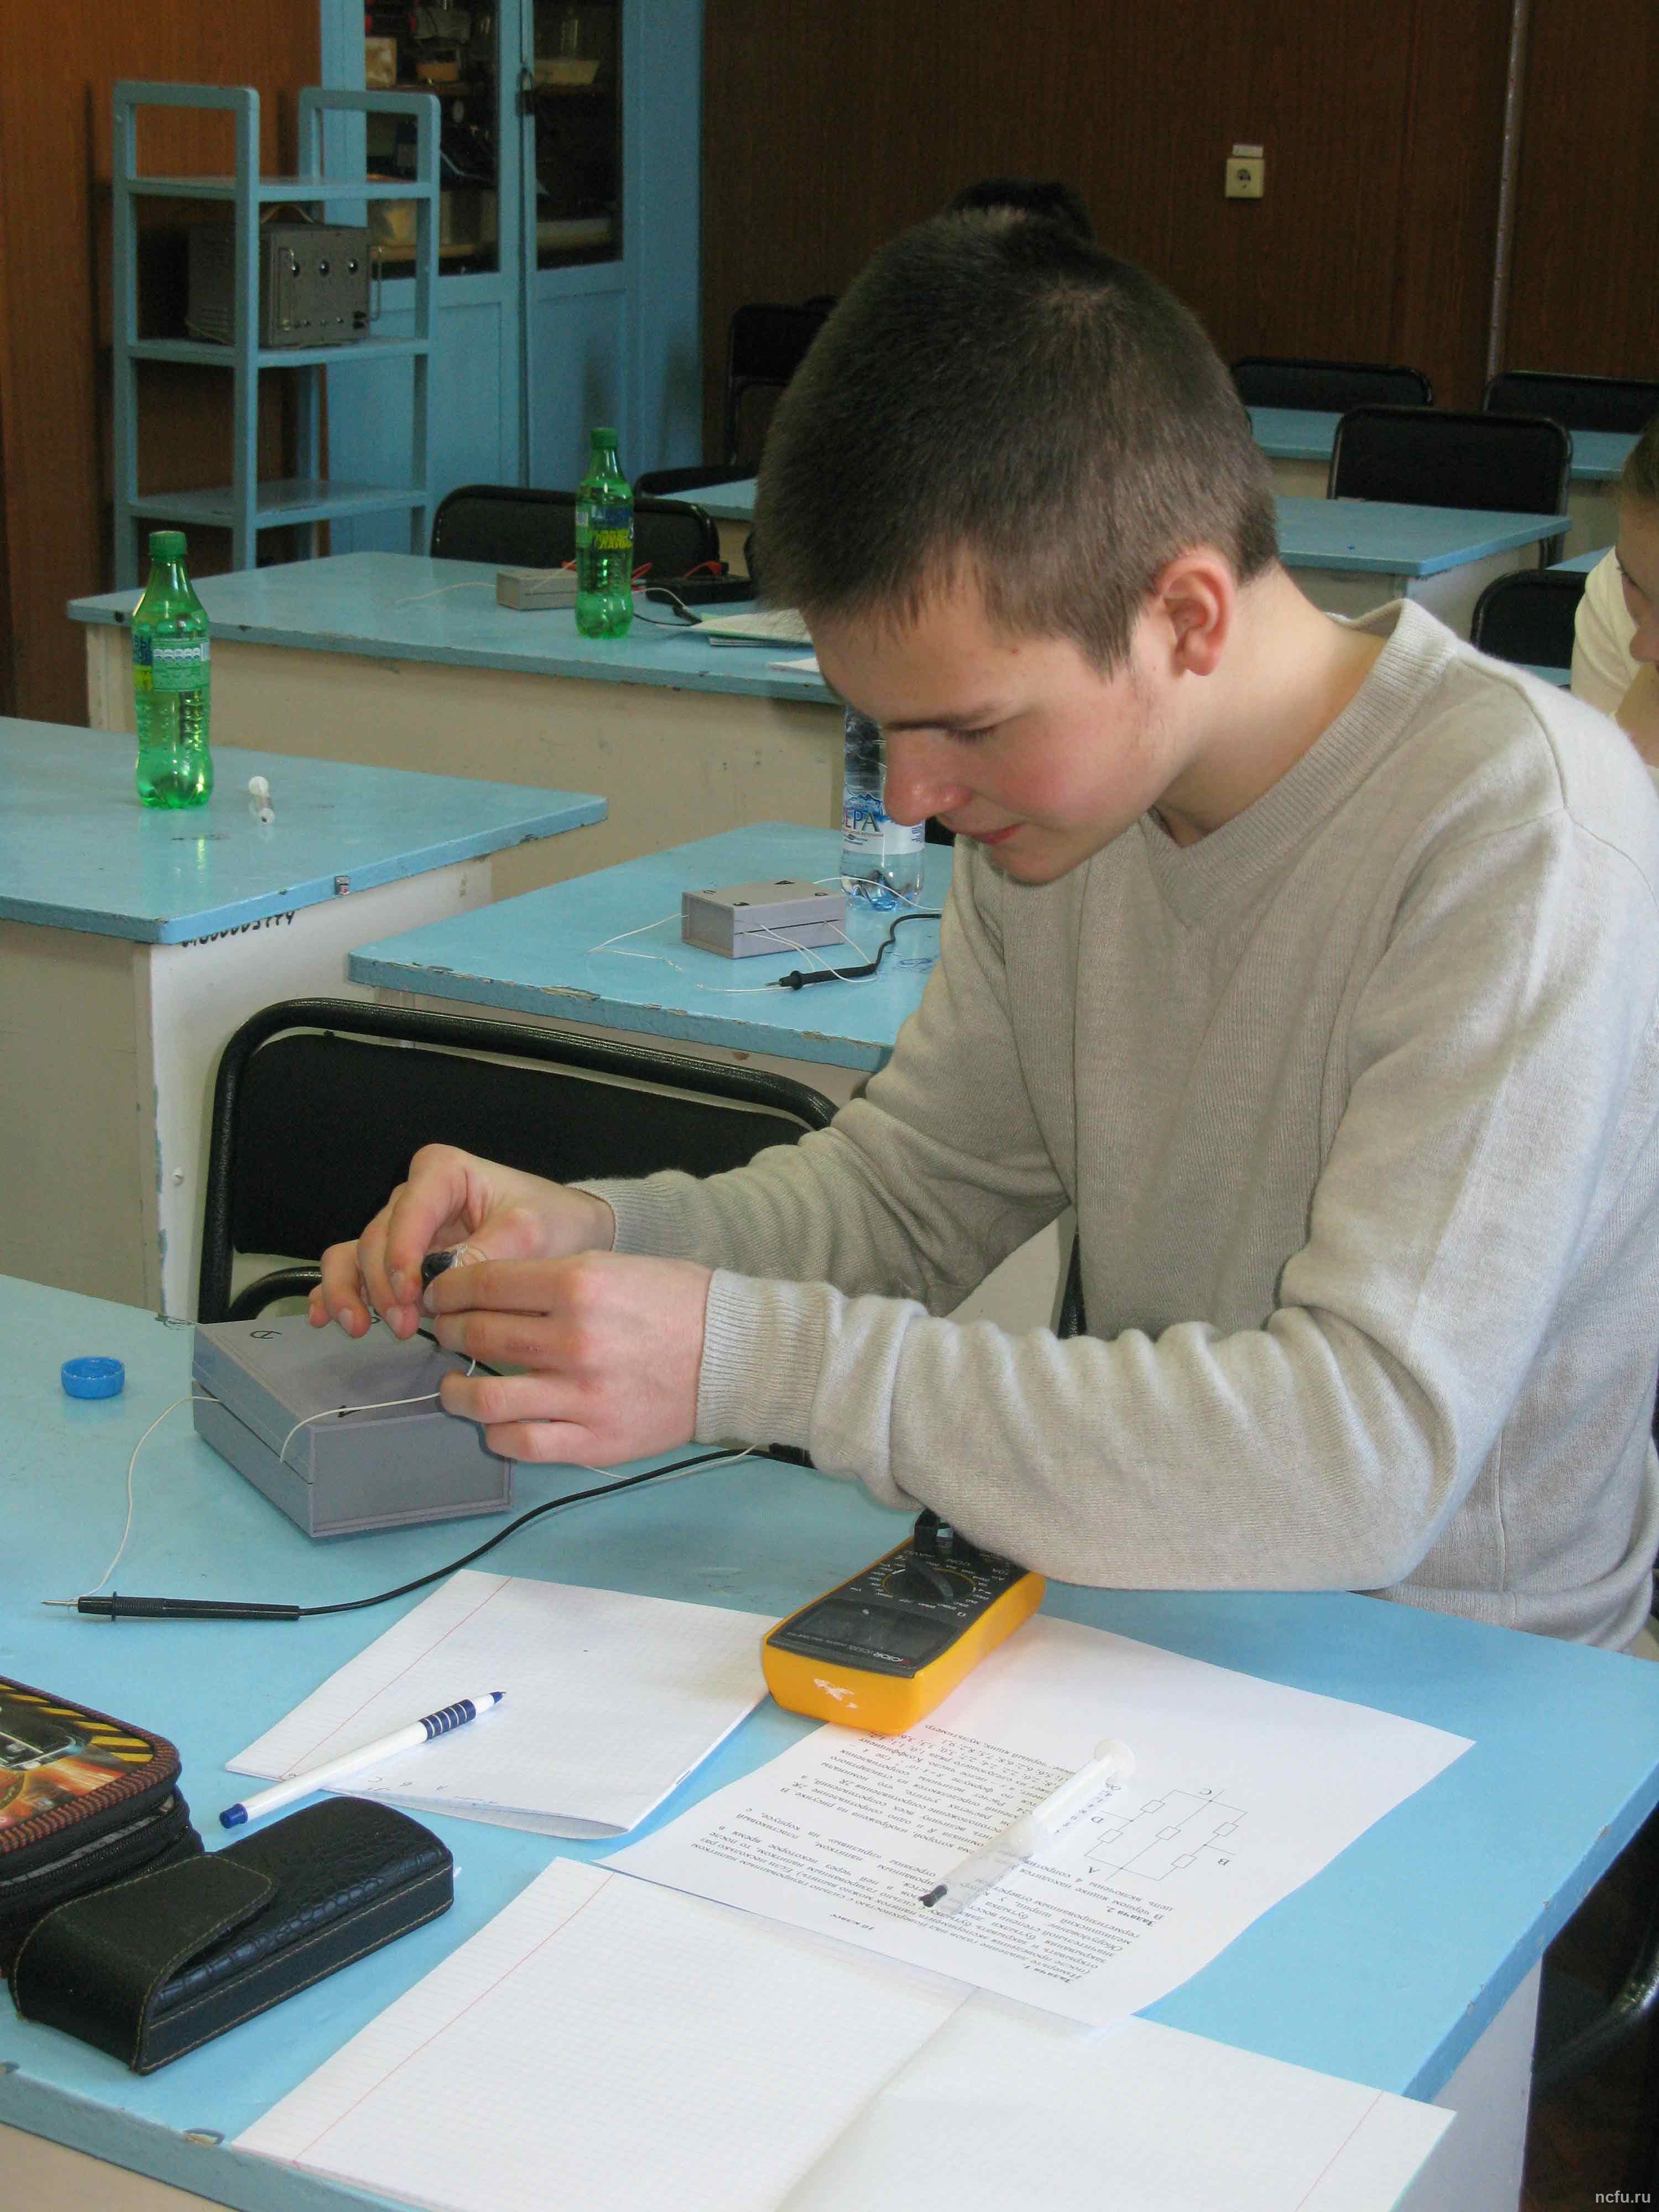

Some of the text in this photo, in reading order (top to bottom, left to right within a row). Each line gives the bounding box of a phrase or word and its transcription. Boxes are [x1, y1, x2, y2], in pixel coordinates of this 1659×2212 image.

[821, 1762, 869, 1781] номиналы
[830, 1756, 894, 1779] стандартного
[811, 1788, 883, 1814] сопротивление
[854, 1784, 926, 1809] сопротивления
[912, 1783, 980, 1807] определяются
[887, 1814, 912, 1824] одно
[893, 1806, 915, 1815] всех
[926, 1807, 1003, 1833] естоположение
[851, 1812, 909, 1833] изображена
[919, 1815, 967, 1832] величину
[732, 1831, 761, 1844] время
[940, 1831, 985, 1848] оминала
[691, 1843, 738, 1861] напитком
[768, 1844, 818, 1864] некоторое
[825, 1864, 852, 1876] через
[889, 1859, 937, 1877] отрезаны
[1217, 1858, 1230, 1866] B
[738, 1860, 809, 1886] газированным
[806, 1866, 878, 1893] газированным
[875, 1863, 936, 1886] ированным
[1019, 1868, 1072, 1889] находится
[809, 1884, 846, 1898] сильно
[839, 1886, 874, 1901] можно
[880, 1892, 916, 1907] сильно
[1074, 1887, 1109, 1901] ящике
[1088, 1882, 1142, 1902] включены
[928, 1909, 972, 1927] бутылку
[985, 1901, 1029, 1919] бутылка
[1034, 1900, 1140, 1938] герметизированным
[1117, 1910, 1155, 1926] Задача
[990, 1922, 1036, 1940] бутылки
[998, 1915, 1041, 1932] степени
[1060, 1918, 1133, 1945] медицинский
[975, 1925, 1029, 1945] закрывать
[1041, 1930, 1114, 1957] значительной
[1044, 1939, 1107, 1963] закрывания
[1044, 1948, 1098, 1969] открывать
